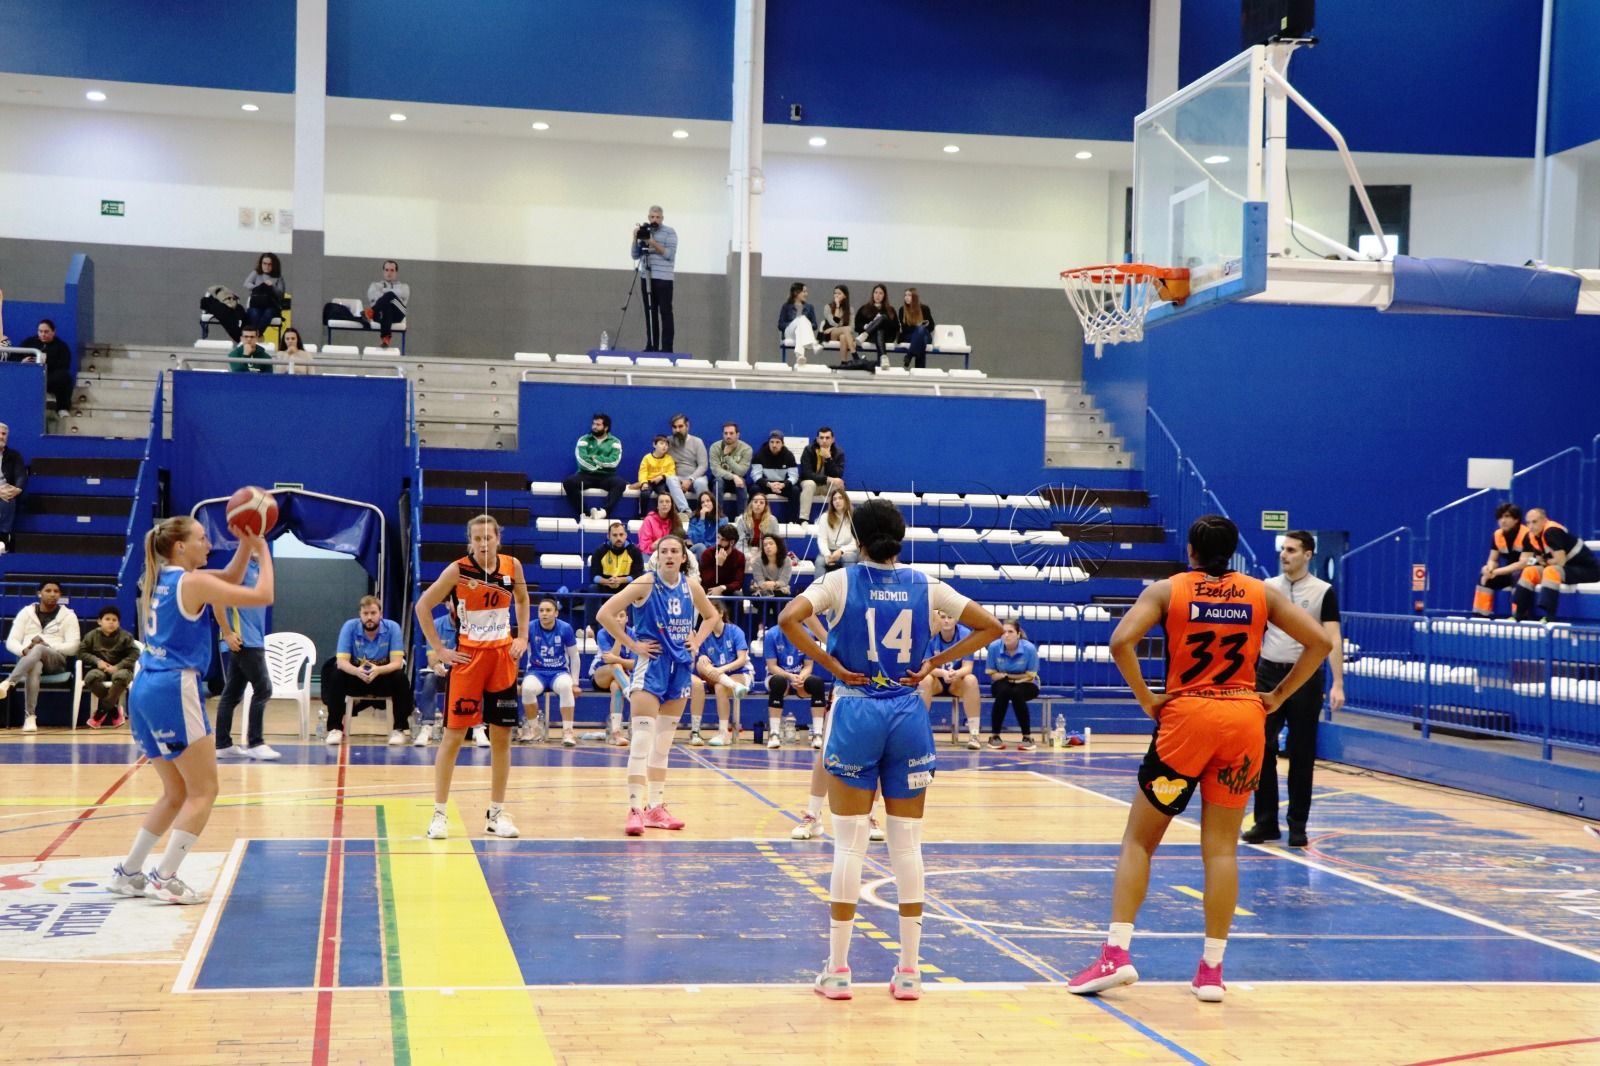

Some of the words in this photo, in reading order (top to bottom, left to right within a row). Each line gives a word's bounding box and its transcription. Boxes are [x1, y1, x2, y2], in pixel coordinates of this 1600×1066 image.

[483, 591, 500, 608] 10
[870, 590, 909, 602] MBOMIO
[1194, 582, 1246, 601] Ezeigbo
[667, 598, 682, 616] 18
[1205, 608, 1248, 620] AQUONA
[865, 607, 914, 664] 14
[540, 645, 555, 657] 24
[1180, 630, 1249, 685] 33
[796, 655, 804, 666] 0
[43, 902, 117, 938] MELILLA
